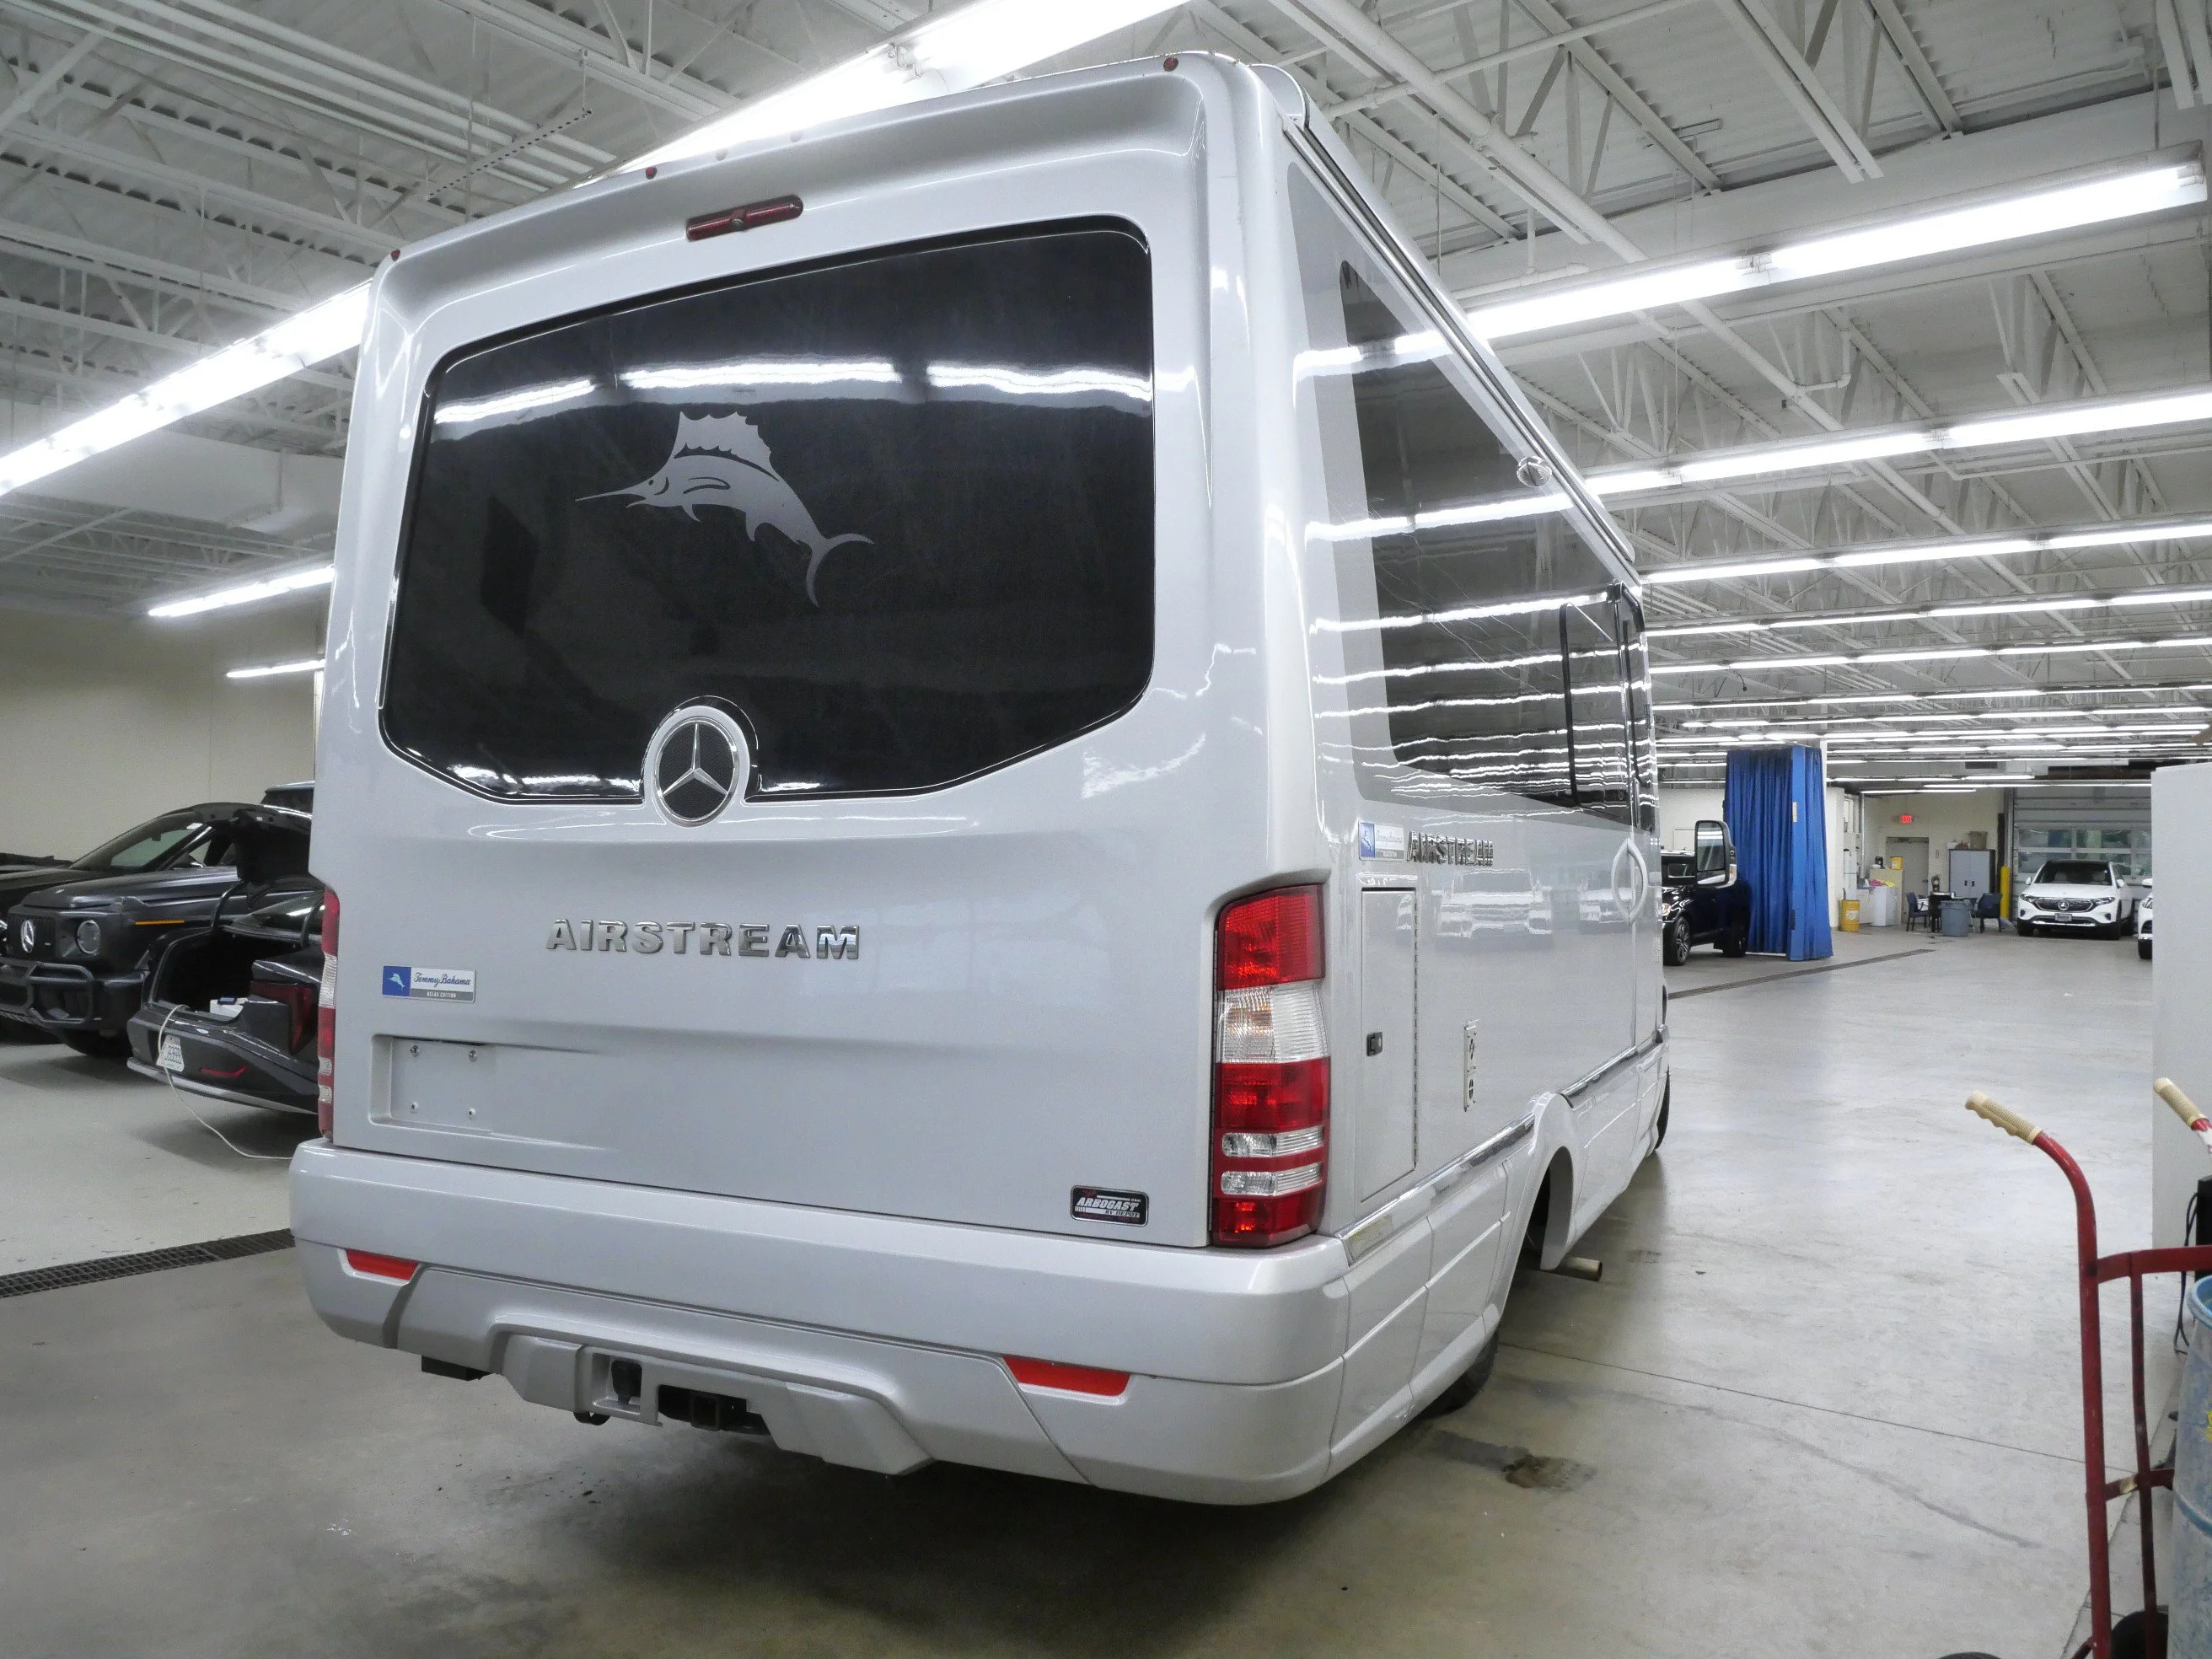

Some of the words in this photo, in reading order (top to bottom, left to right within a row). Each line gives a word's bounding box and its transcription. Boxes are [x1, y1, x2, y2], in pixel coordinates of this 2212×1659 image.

[1406, 830, 1493, 867] AIRSTREAM
[545, 918, 859, 959] AIRSTREAM
[414, 972, 440, 987] Tommy
[441, 974, 471, 985] Bahama
